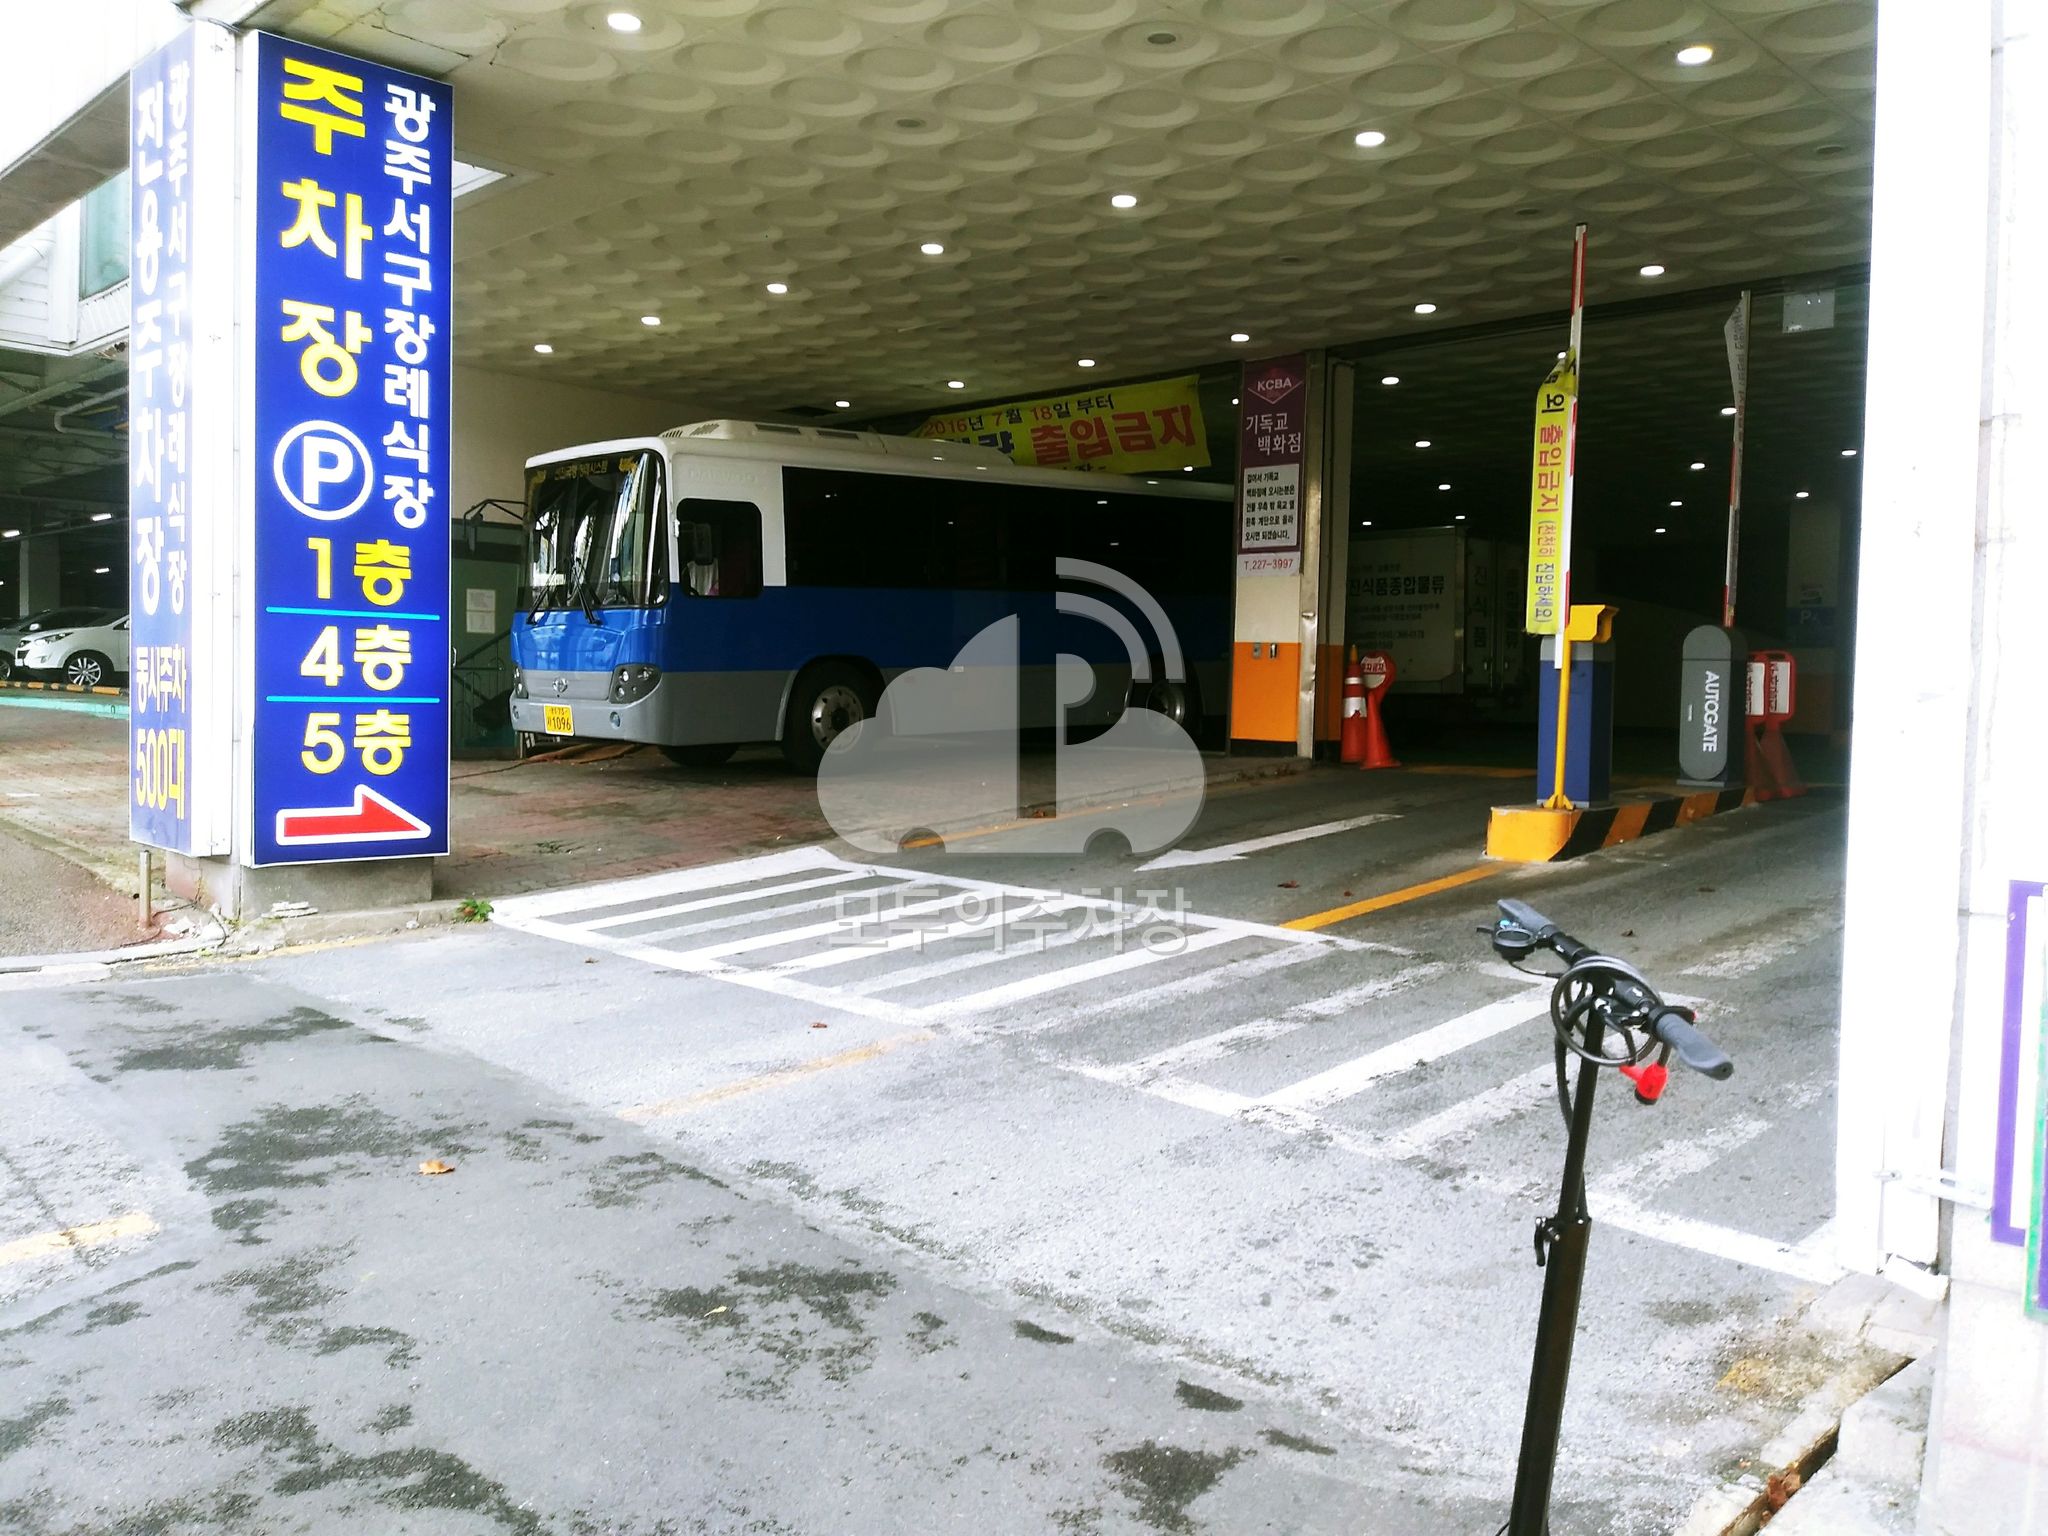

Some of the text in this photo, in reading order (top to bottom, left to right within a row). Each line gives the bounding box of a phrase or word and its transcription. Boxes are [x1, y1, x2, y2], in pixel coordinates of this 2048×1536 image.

[280, 58, 373, 398] 주차장
[924, 393, 1115, 438] 2016년 7월 18일 부터
[1257, 378, 1293, 392] KCBA
[1541, 392, 1564, 414] 외
[1029, 404, 1197, 466] 출입금지
[1245, 412, 1289, 435] 기독교
[1258, 432, 1302, 456] 백화점
[1537, 424, 1563, 513] 출입금지
[308, 537, 412, 606] 1층
[300, 624, 412, 692] 4층
[301, 709, 412, 776] 5층
[1702, 670, 1720, 753] AUTOGATE
[135, 727, 185, 821] 500대
